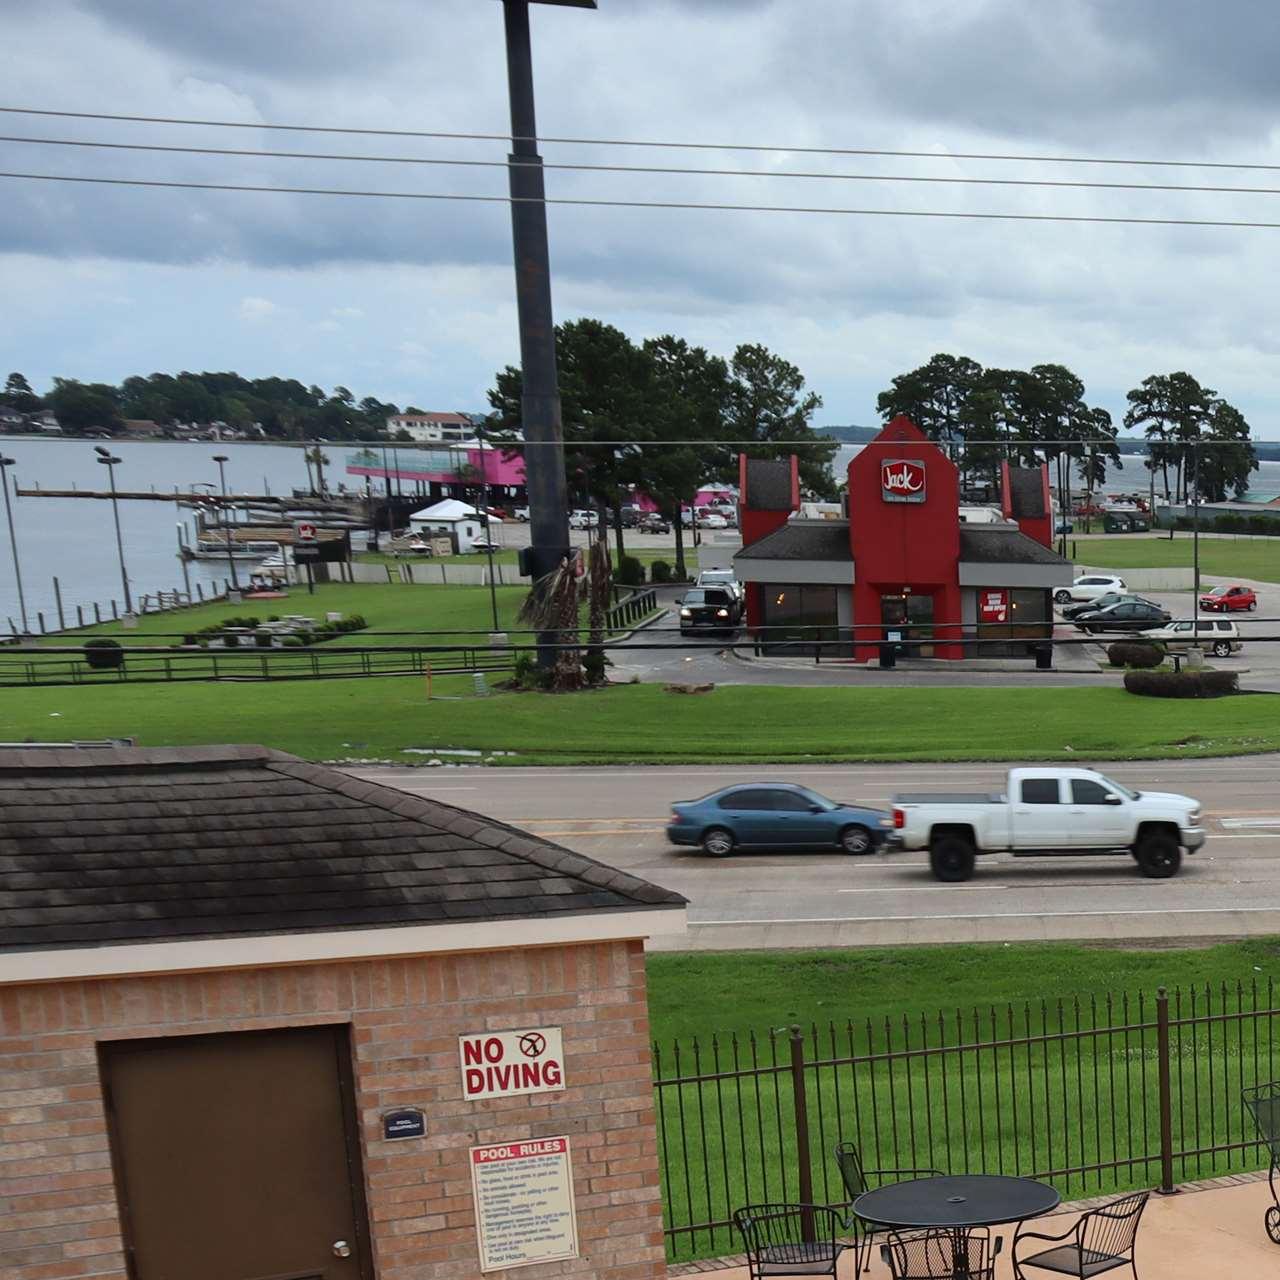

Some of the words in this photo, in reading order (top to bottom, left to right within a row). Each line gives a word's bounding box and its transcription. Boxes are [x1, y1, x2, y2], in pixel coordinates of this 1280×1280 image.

[884, 464, 923, 491] Jack
[463, 1037, 504, 1066] NO
[466, 1059, 562, 1095] DIVING
[480, 1147, 514, 1161] POOL
[520, 1140, 561, 1156] RULES
